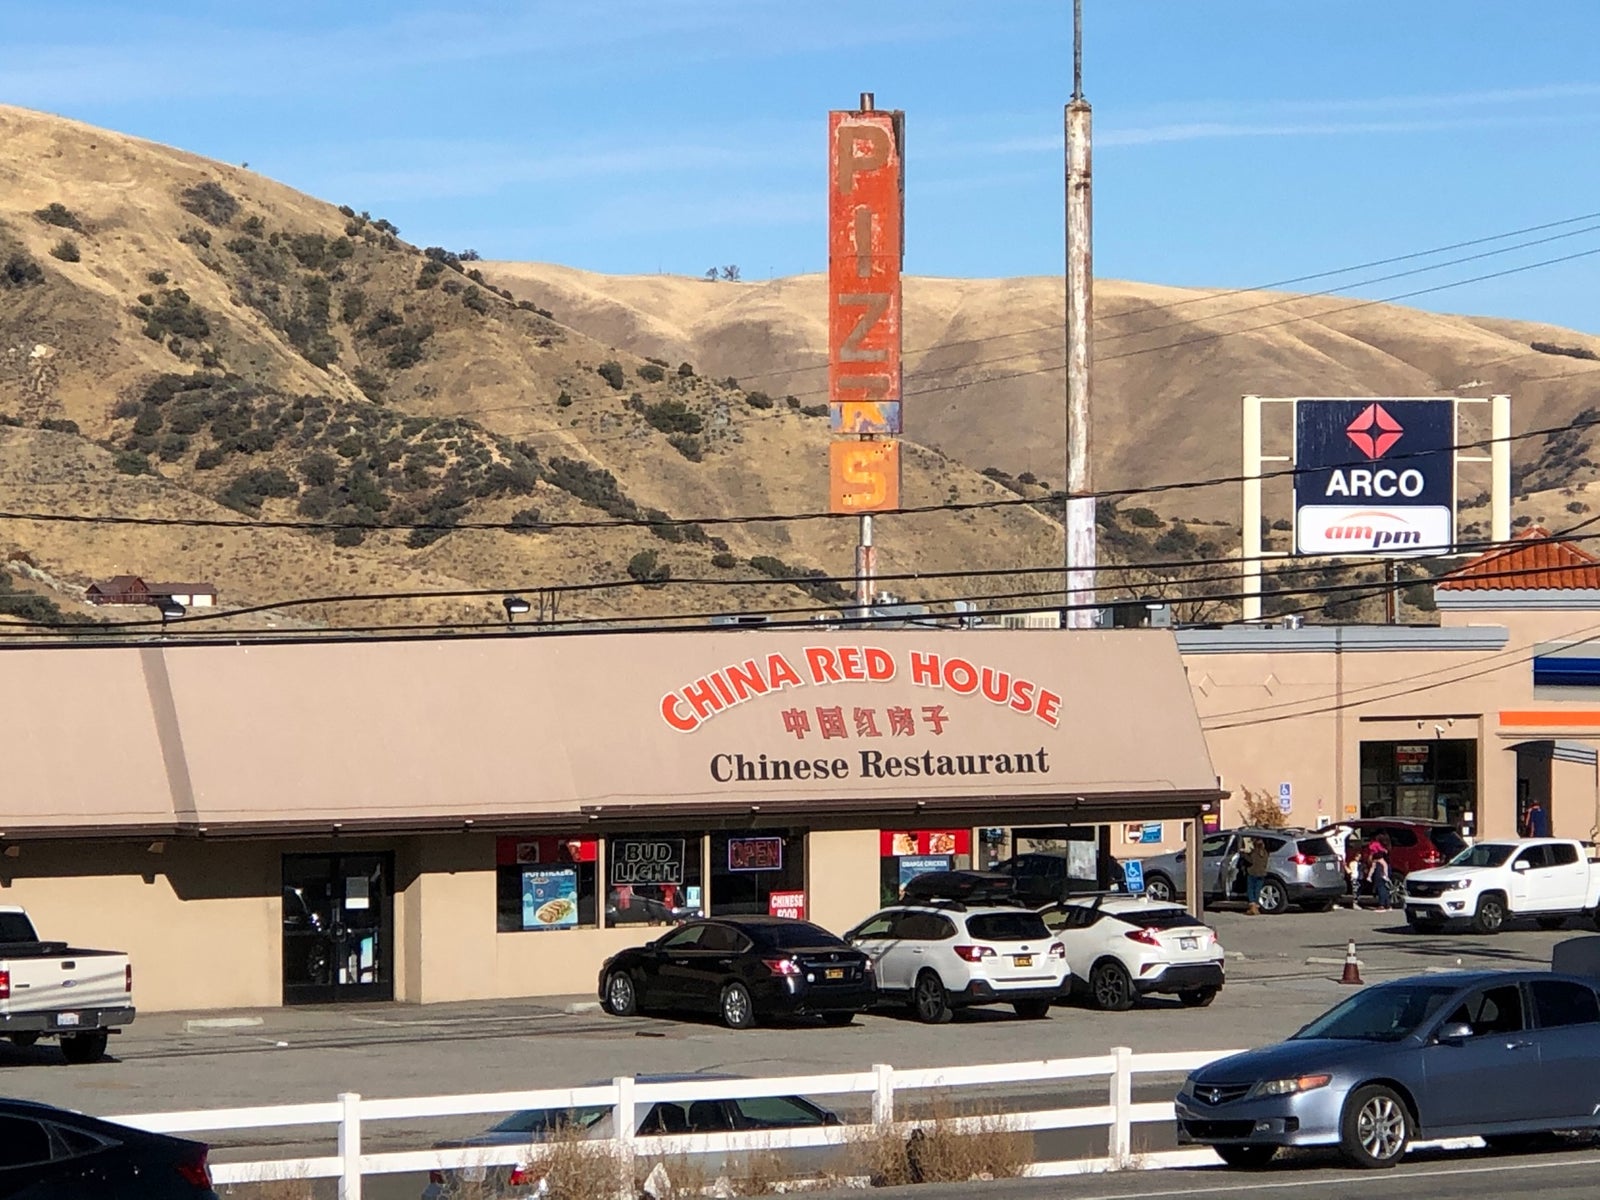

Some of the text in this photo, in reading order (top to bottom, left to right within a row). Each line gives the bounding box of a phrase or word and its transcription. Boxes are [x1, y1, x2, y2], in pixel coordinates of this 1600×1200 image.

[1325, 469, 1424, 497] ARCO
[1325, 525, 1421, 548] ampm
[660, 646, 1064, 733] CHINA RED HOUSE
[781, 705, 949, 740] 中国红房子
[710, 746, 1050, 783] Chinese Restaurant
[625, 843, 672, 862] BUD
[731, 841, 779, 867] OPEN
[615, 862, 679, 882] LIGHT
[771, 894, 804, 908] CHINESE
[777, 908, 798, 919] FOOD
